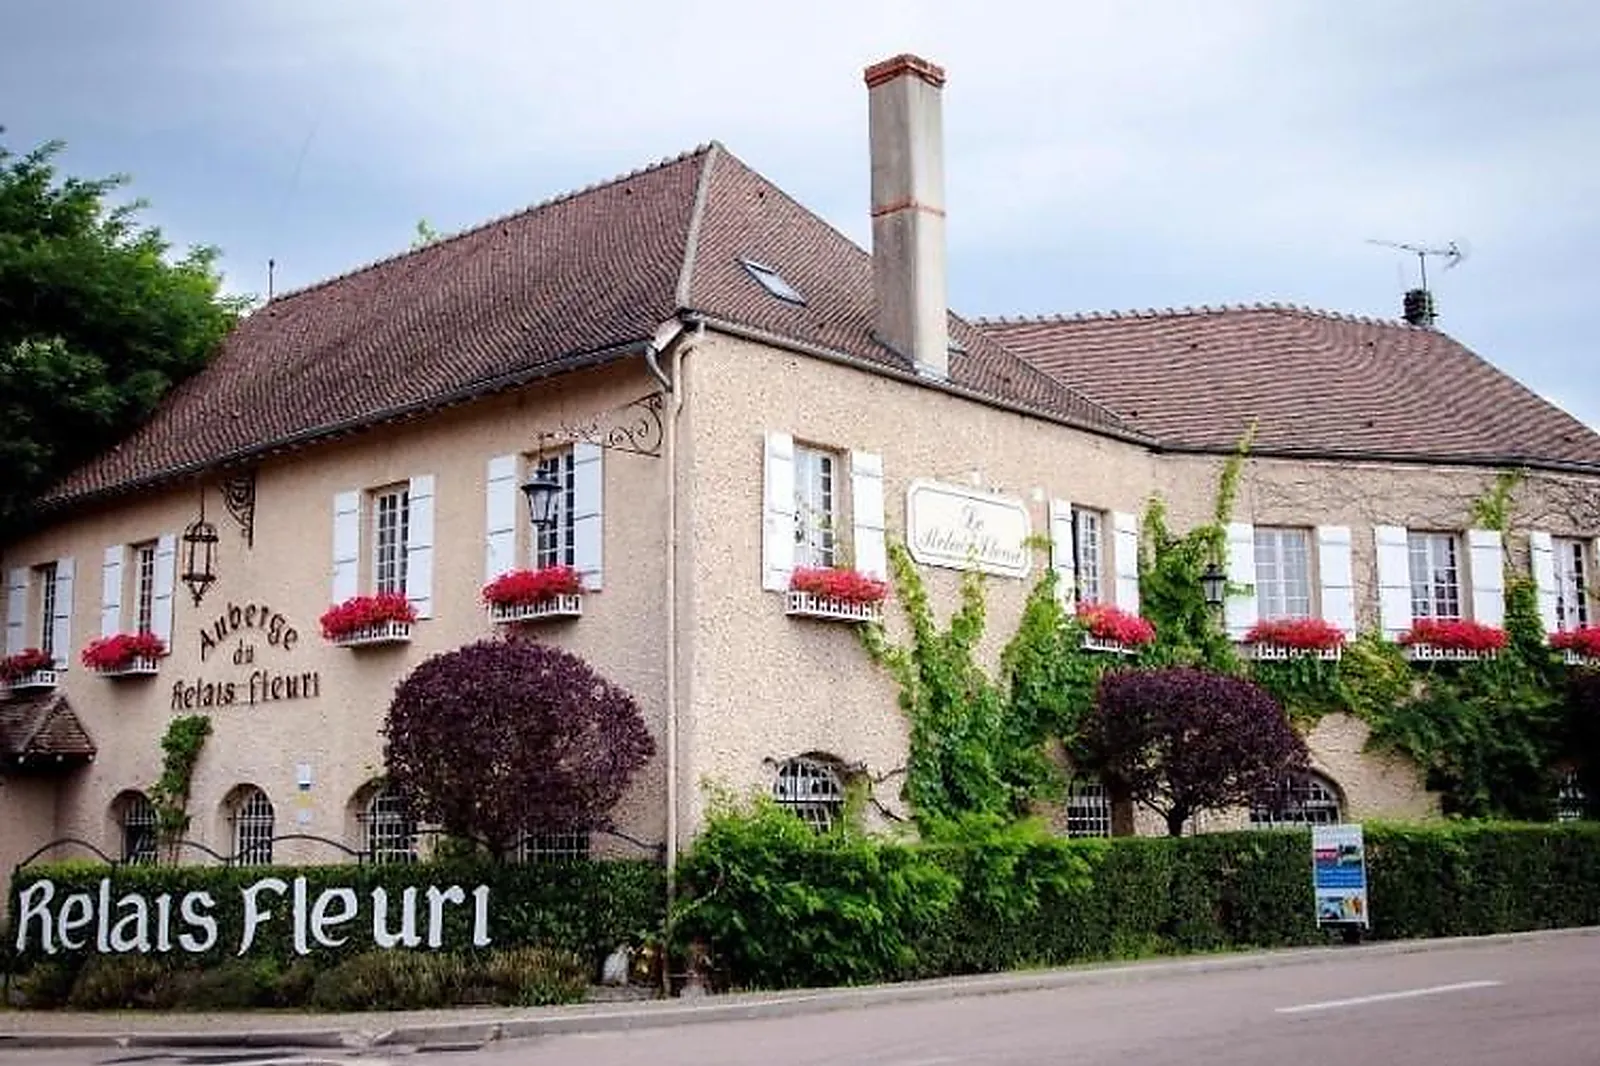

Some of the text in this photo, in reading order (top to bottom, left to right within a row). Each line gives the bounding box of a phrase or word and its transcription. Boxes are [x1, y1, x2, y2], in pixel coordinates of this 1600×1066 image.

[200, 602, 298, 662] Auberge
[233, 638, 254, 665] du
[171, 677, 235, 710] Relais
[15, 876, 492, 957] Relais Fleuri
